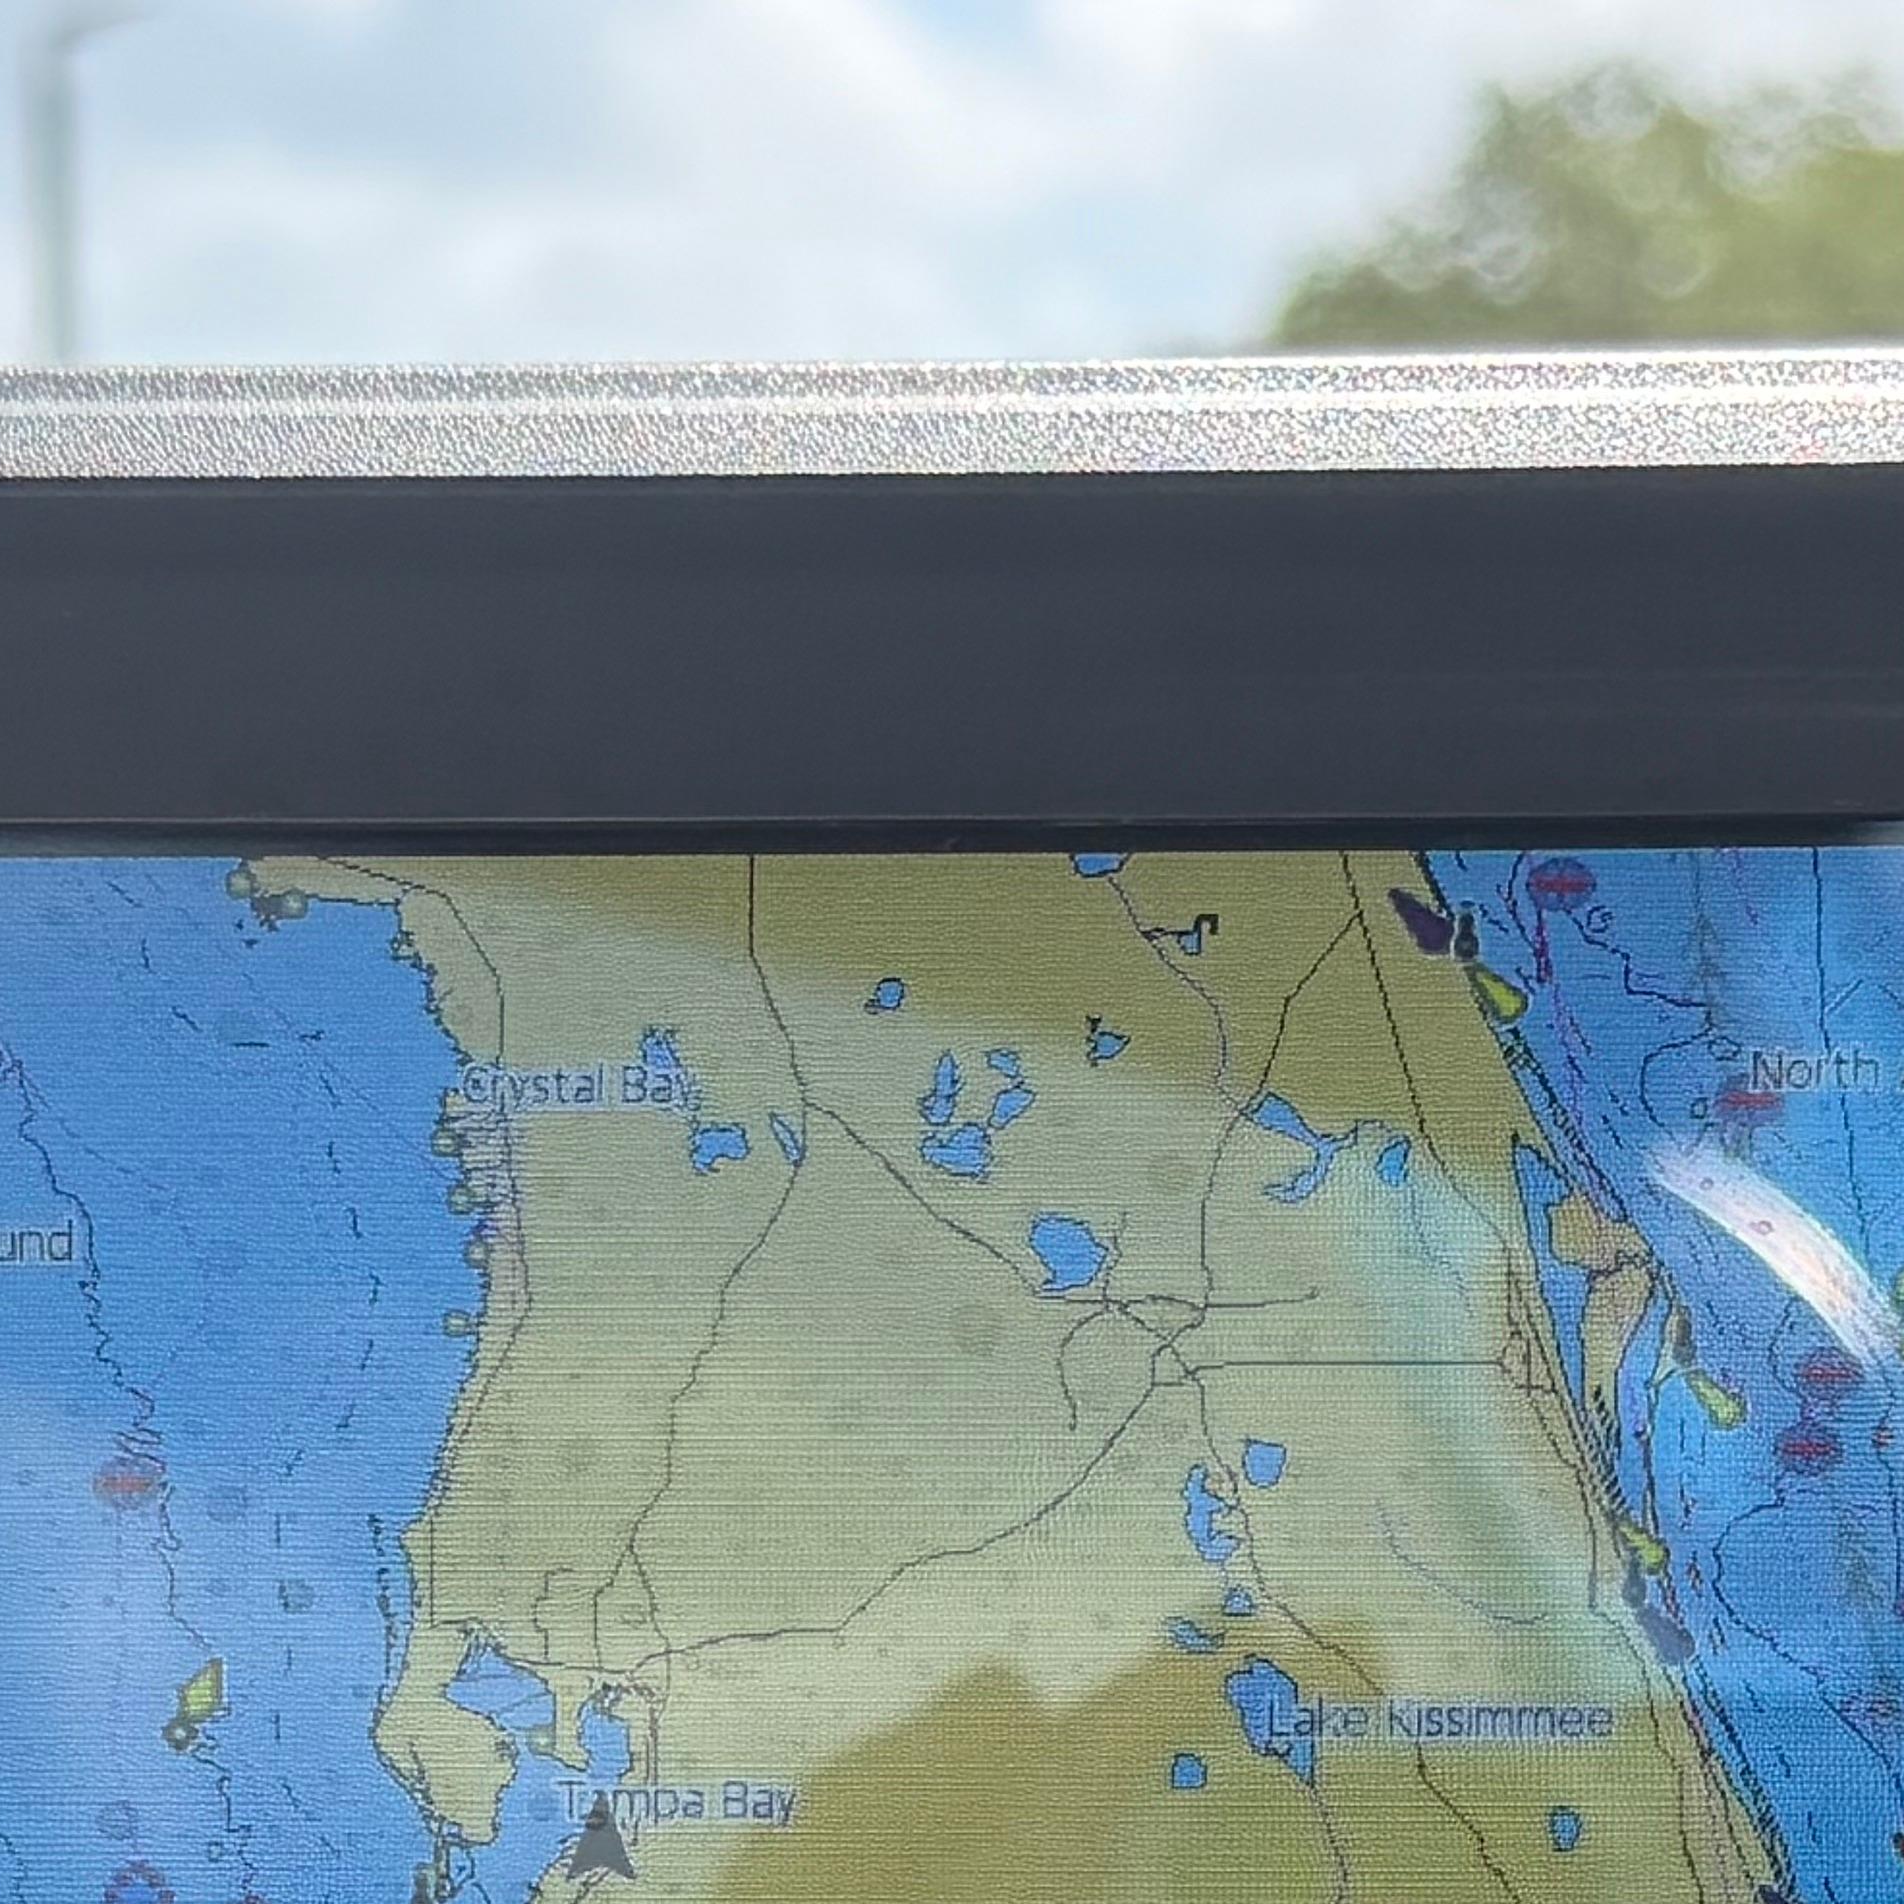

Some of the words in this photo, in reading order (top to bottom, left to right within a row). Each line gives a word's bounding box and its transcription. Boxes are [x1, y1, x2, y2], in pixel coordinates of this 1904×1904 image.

[462, 1062, 605, 1109] Crystal
[1750, 1049, 1878, 1087] North
[1270, 1698, 1370, 1738] Lake
[558, 1780, 703, 1828] Tampa
[723, 1780, 800, 1828] Bay
